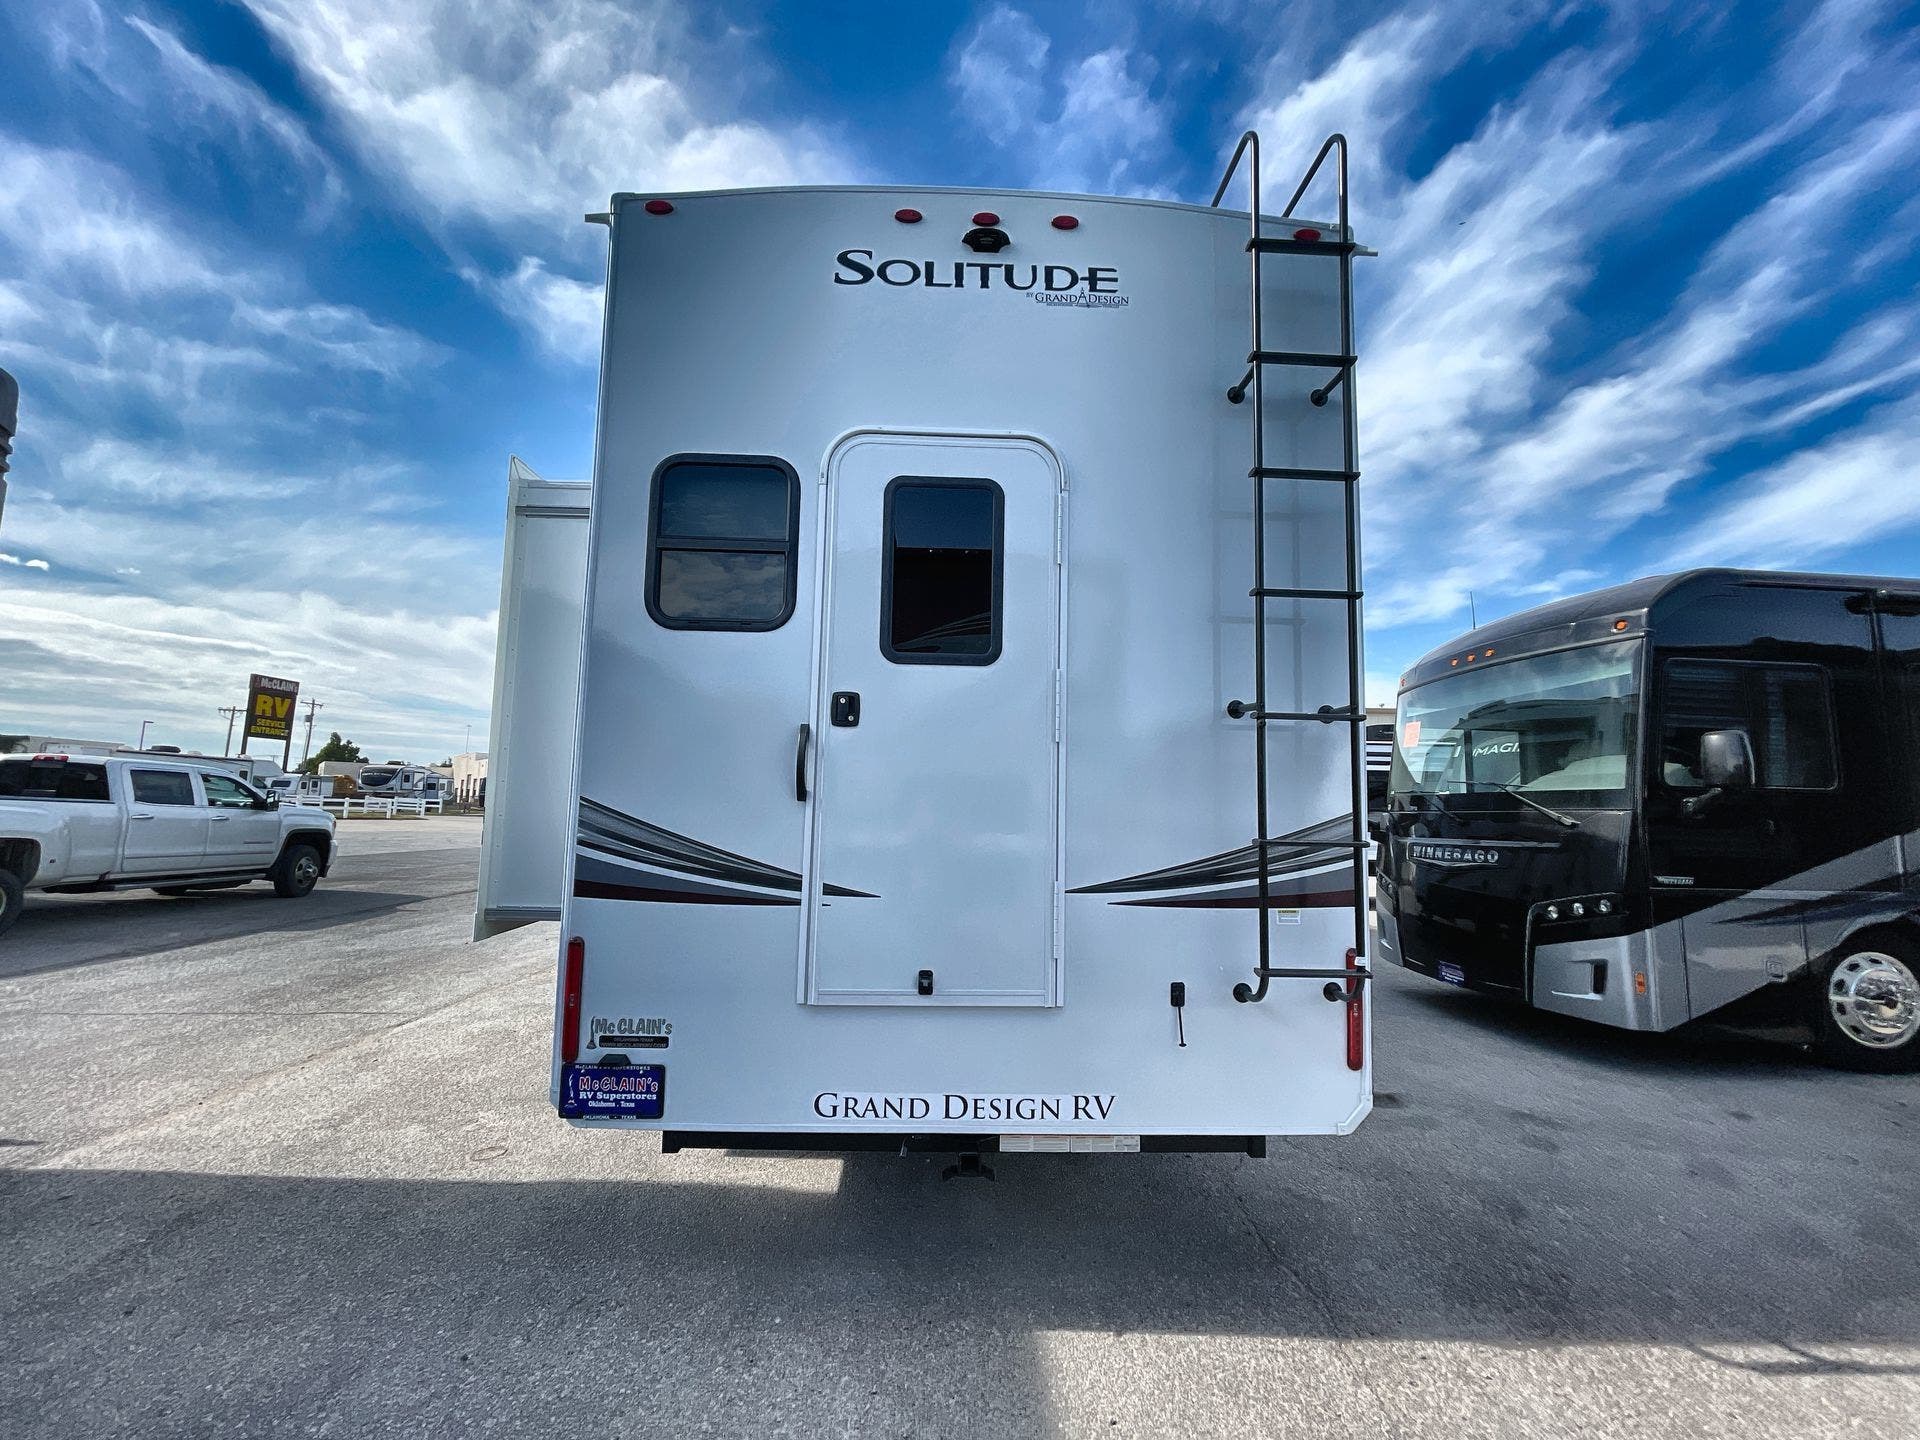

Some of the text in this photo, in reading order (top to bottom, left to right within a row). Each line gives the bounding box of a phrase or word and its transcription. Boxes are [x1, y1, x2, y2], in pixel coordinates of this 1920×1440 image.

[833, 249, 1119, 293] SOLITUDE
[1035, 292, 1077, 303] GRAND
[1088, 293, 1129, 305] DESIGN
[255, 694, 292, 718] RV
[256, 718, 286, 728] SERVICE
[250, 726, 289, 737] ENTRANCE
[1413, 845, 1499, 863] WINNEBAGO
[579, 1091, 657, 1101] RV Superstores
[588, 1100, 615, 1108] Oklahoma
[813, 1092, 1116, 1120] GRAND DESIGN RV
